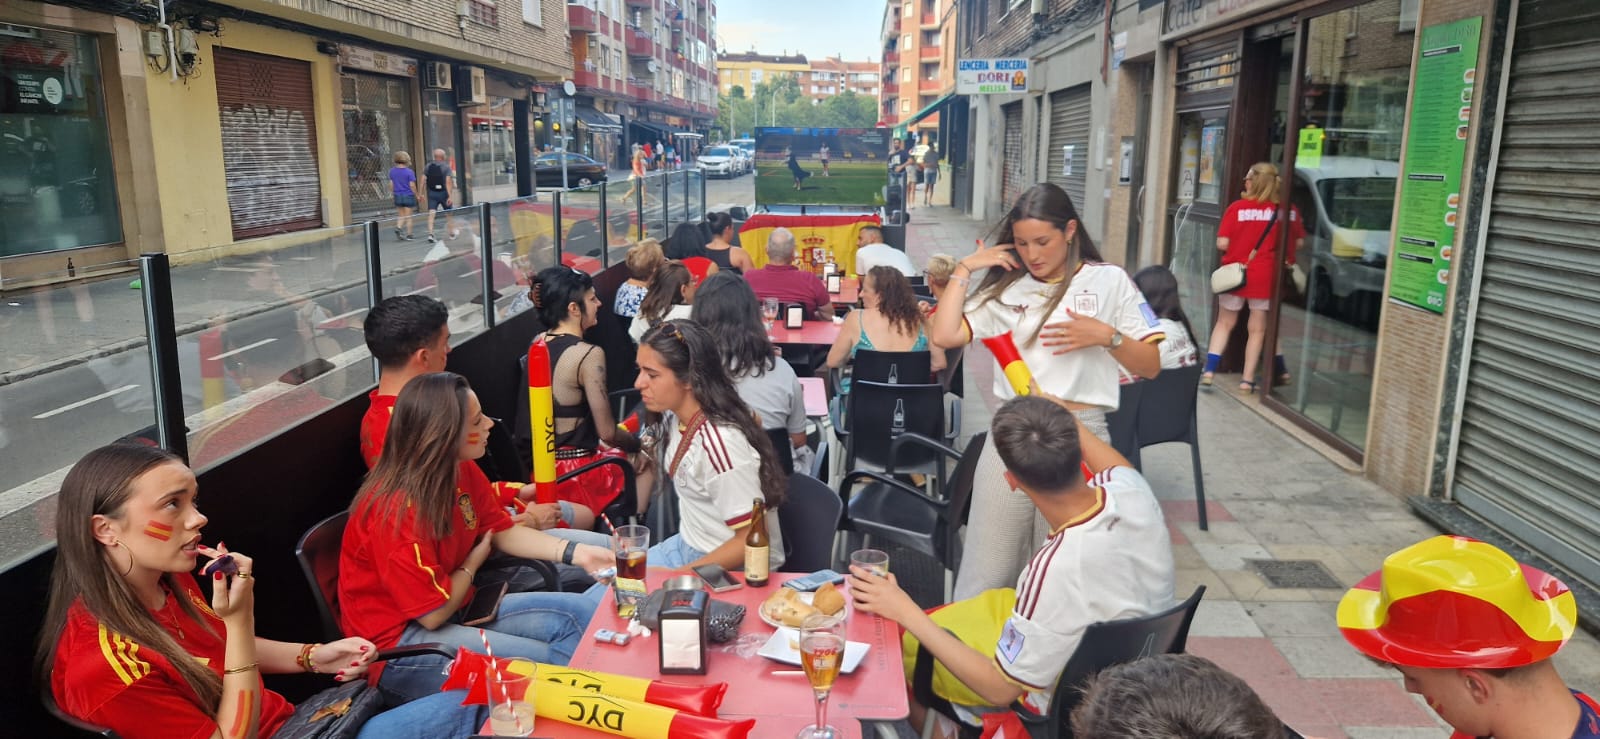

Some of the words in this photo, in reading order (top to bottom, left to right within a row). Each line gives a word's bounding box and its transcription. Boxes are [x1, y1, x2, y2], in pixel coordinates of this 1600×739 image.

[960, 61, 989, 70] LENCERIA
[995, 60, 1027, 70] MERCERIA
[978, 72, 1009, 83] DORI
[545, 416, 555, 454] DYC
[567, 700, 625, 731] DYC
